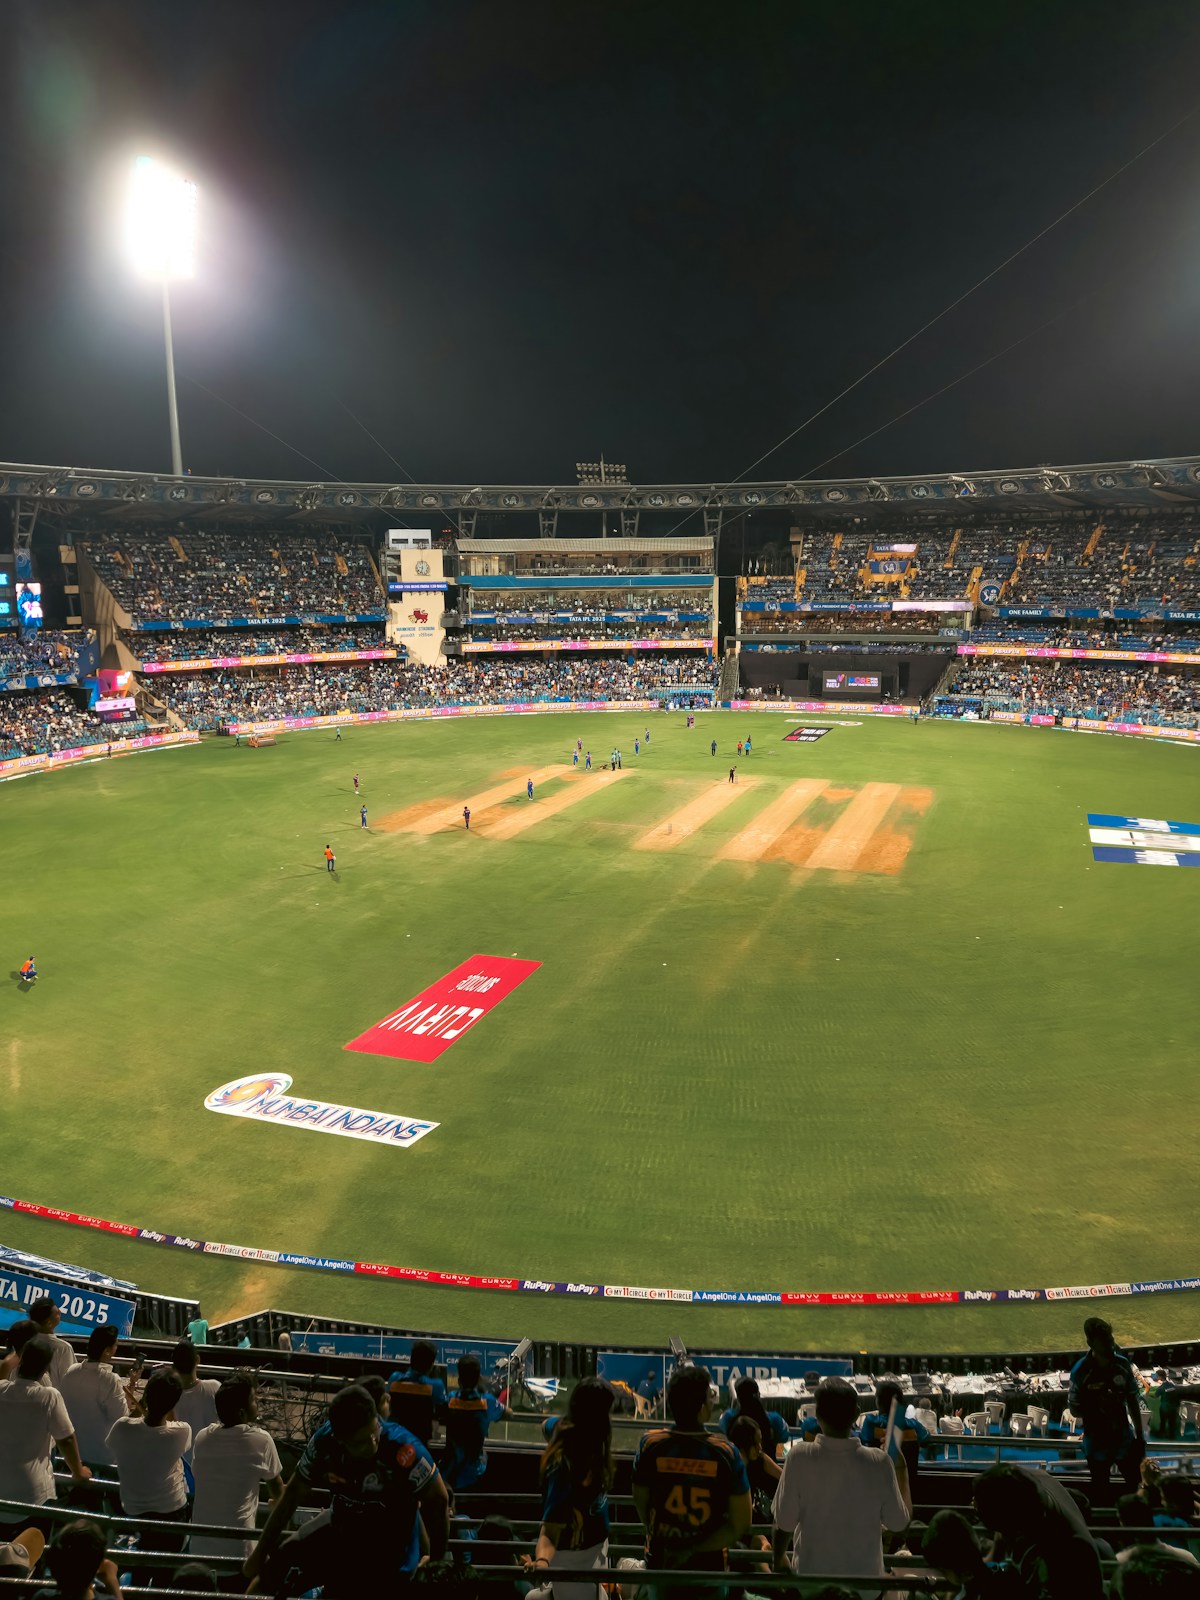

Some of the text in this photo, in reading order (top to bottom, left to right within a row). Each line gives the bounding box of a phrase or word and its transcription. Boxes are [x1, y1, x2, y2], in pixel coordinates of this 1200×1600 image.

[378, 1000, 484, 1040] CURVV
[249, 1097, 431, 1140] MUMBAI INDIANS
[19, 1202, 40, 1210] CURVV
[48, 1209, 70, 1217] CURVV
[78, 1216, 101, 1224] CURVV
[109, 1222, 133, 1231] CURVV
[140, 1230, 163, 1241] RuPay
[174, 1236, 197, 1249] RuPay
[524, 1281, 551, 1292] RuPay
[566, 1284, 594, 1294] RuPay
[964, 1291, 992, 1300] RuPay
[1008, 1290, 1036, 1300] RuPay
[59, 1293, 109, 1324] 2025
[664, 1484, 711, 1526] 45
